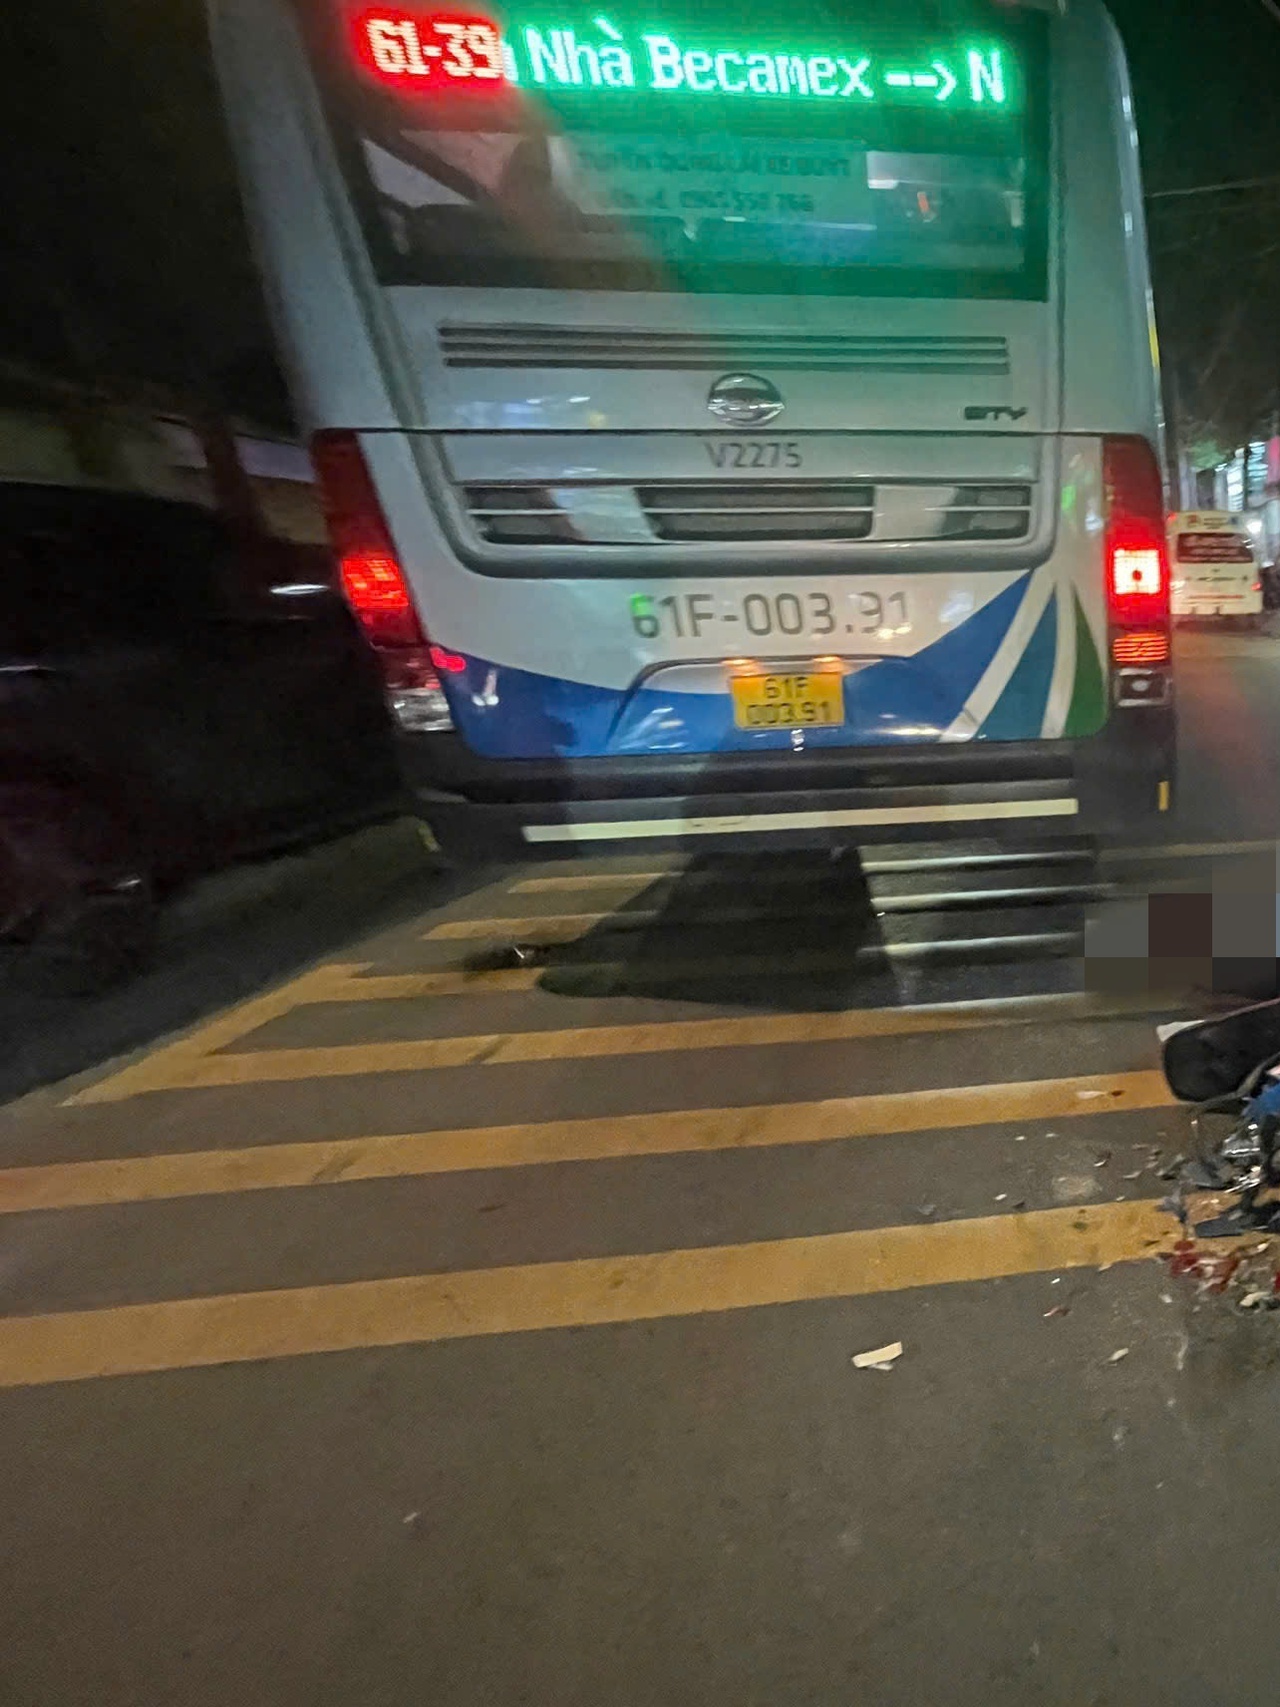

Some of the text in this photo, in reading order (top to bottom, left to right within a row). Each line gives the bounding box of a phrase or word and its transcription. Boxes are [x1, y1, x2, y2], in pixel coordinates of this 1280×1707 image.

[523, 16, 636, 87] Nhà
[642, 33, 875, 99] Becamex
[967, 50, 1005, 103] N
[703, 441, 803, 469] V2275
[630, 590, 908, 638] 61F-003.91
[765, 676, 807, 698] 61F
